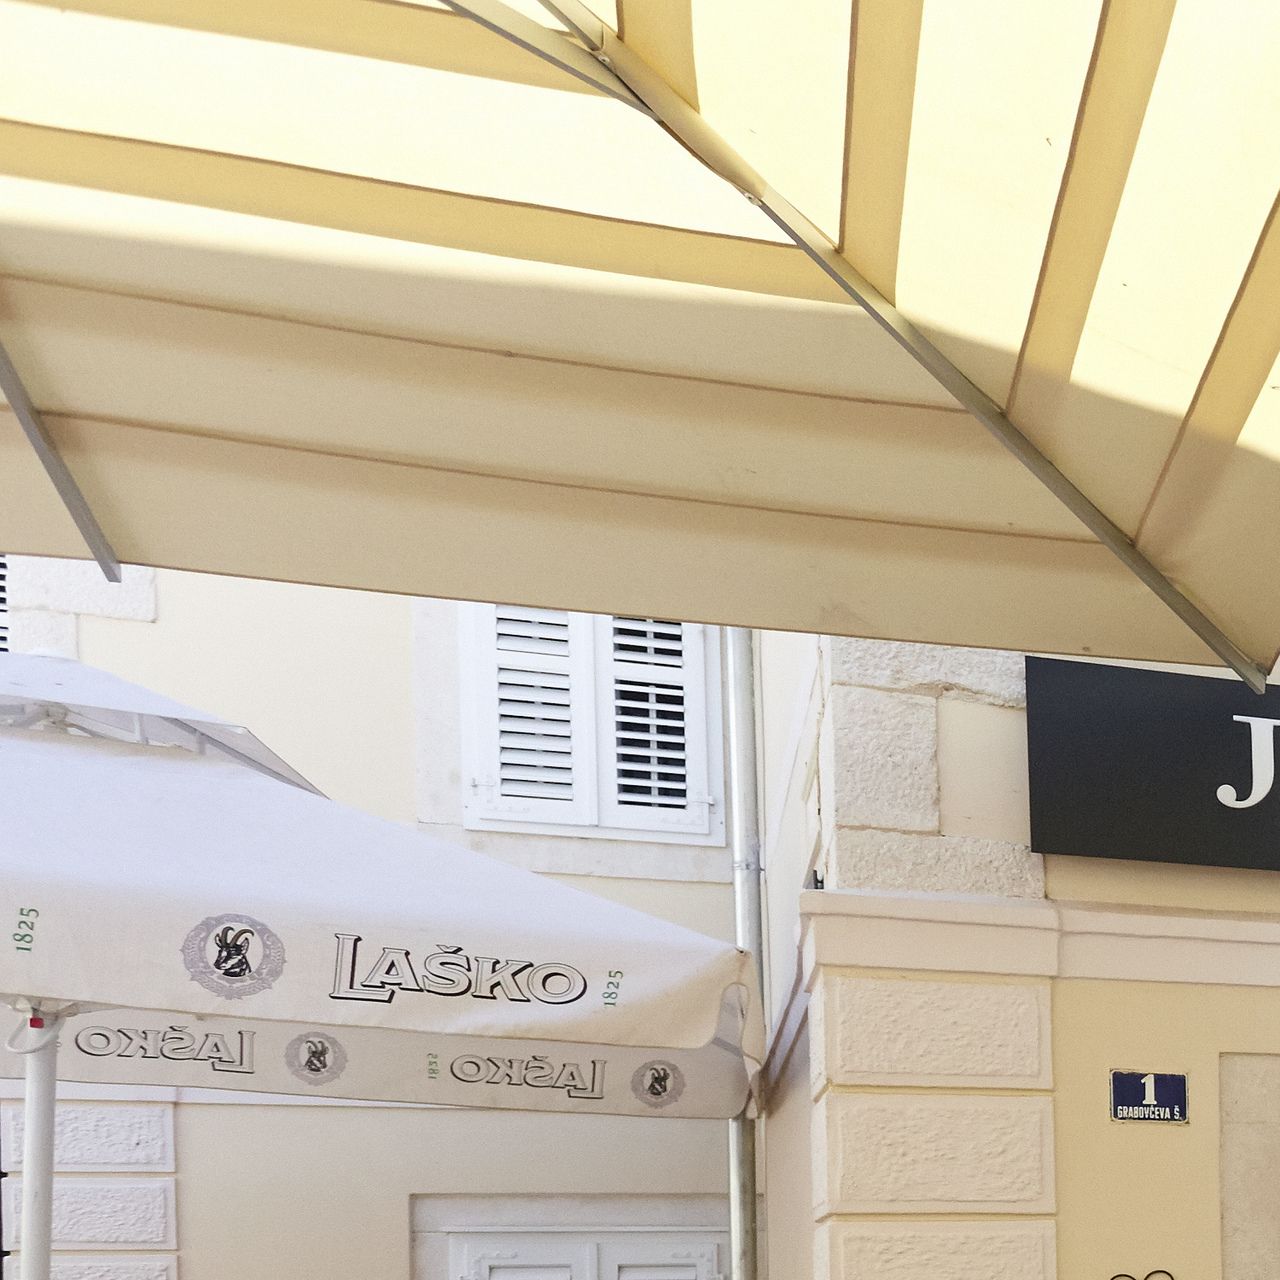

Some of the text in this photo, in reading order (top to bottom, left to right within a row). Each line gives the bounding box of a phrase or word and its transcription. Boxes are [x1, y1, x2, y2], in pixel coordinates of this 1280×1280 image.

[12, 907, 40, 952] 1825
[328, 932, 588, 1005] LAŠKO
[602, 969, 624, 1007] 1825
[1140, 1073, 1157, 1105] 1
